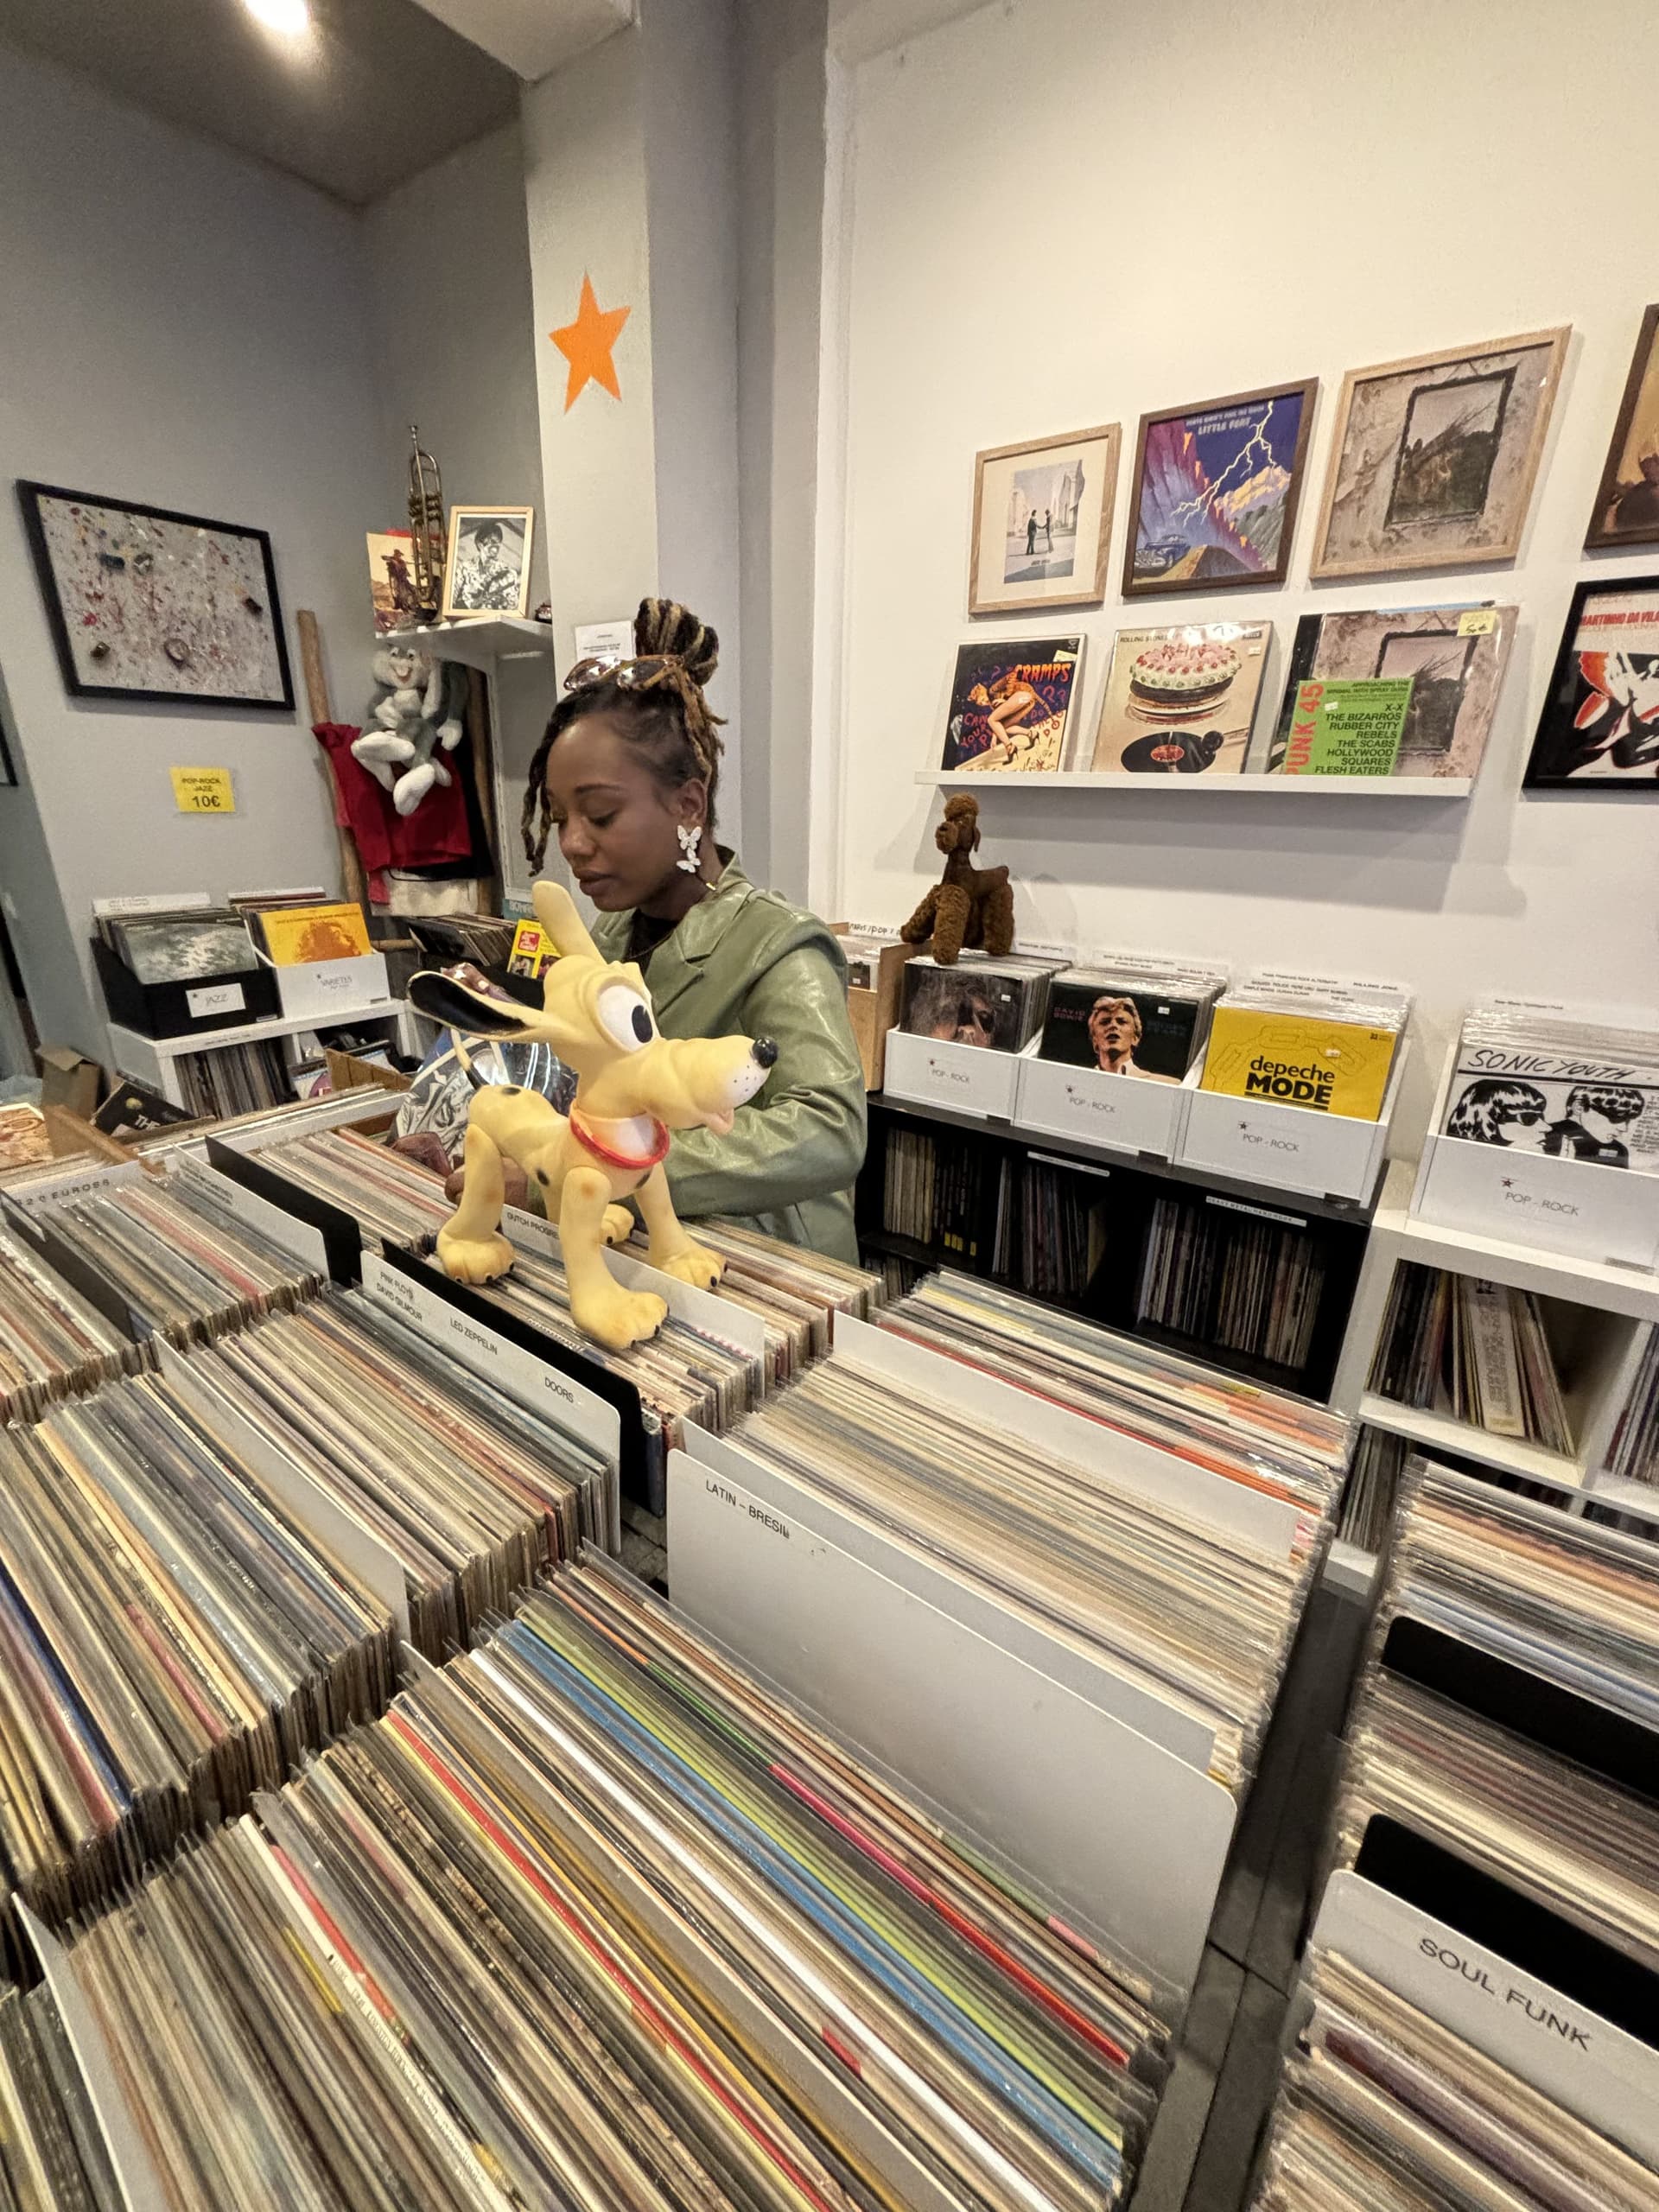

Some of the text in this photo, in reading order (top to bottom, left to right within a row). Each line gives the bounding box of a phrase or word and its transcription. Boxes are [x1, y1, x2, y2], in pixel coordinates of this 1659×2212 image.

[1014, 663, 1072, 683] CRAMPS
[1299, 683, 1325, 714] 45
[1325, 712, 1402, 721] THE BIZARROS
[1329, 721, 1400, 730] RUBBER CITY
[1356, 730, 1397, 739] REBELS
[1314, 766, 1389, 775] FLESH EATERS
[1341, 757, 1391, 766] SQUARES
[192, 795, 221, 808] 10€
[205, 994, 228, 1005] JAZZ
[1249, 1054, 1336, 1084] depeche
[1467, 1049, 1637, 1081] SONIC YOUTH
[931, 1068, 946, 1077] POP
[950, 1071, 969, 1083] ROCK
[1245, 1071, 1334, 1106] MODE
[1069, 1096, 1086, 1107] POP
[1091, 1102, 1116, 1114] ROCK
[1243, 1133, 1263, 1145] POP
[1270, 1138, 1300, 1153] ROCK
[1505, 1192, 1533, 1205] POP
[1541, 1199, 1580, 1217] ROCK
[380, 1271, 395, 1287] PINK
[377, 1282, 423, 1322] DAVID GILMOUR
[449, 1315, 465, 1333] LED
[465, 1324, 499, 1356] ZEPPELIN
[543, 1376, 575, 1404] DOORS
[705, 1478, 738, 1507] LATIN
[1419, 1937, 1592, 2052] SOUL FUNK
